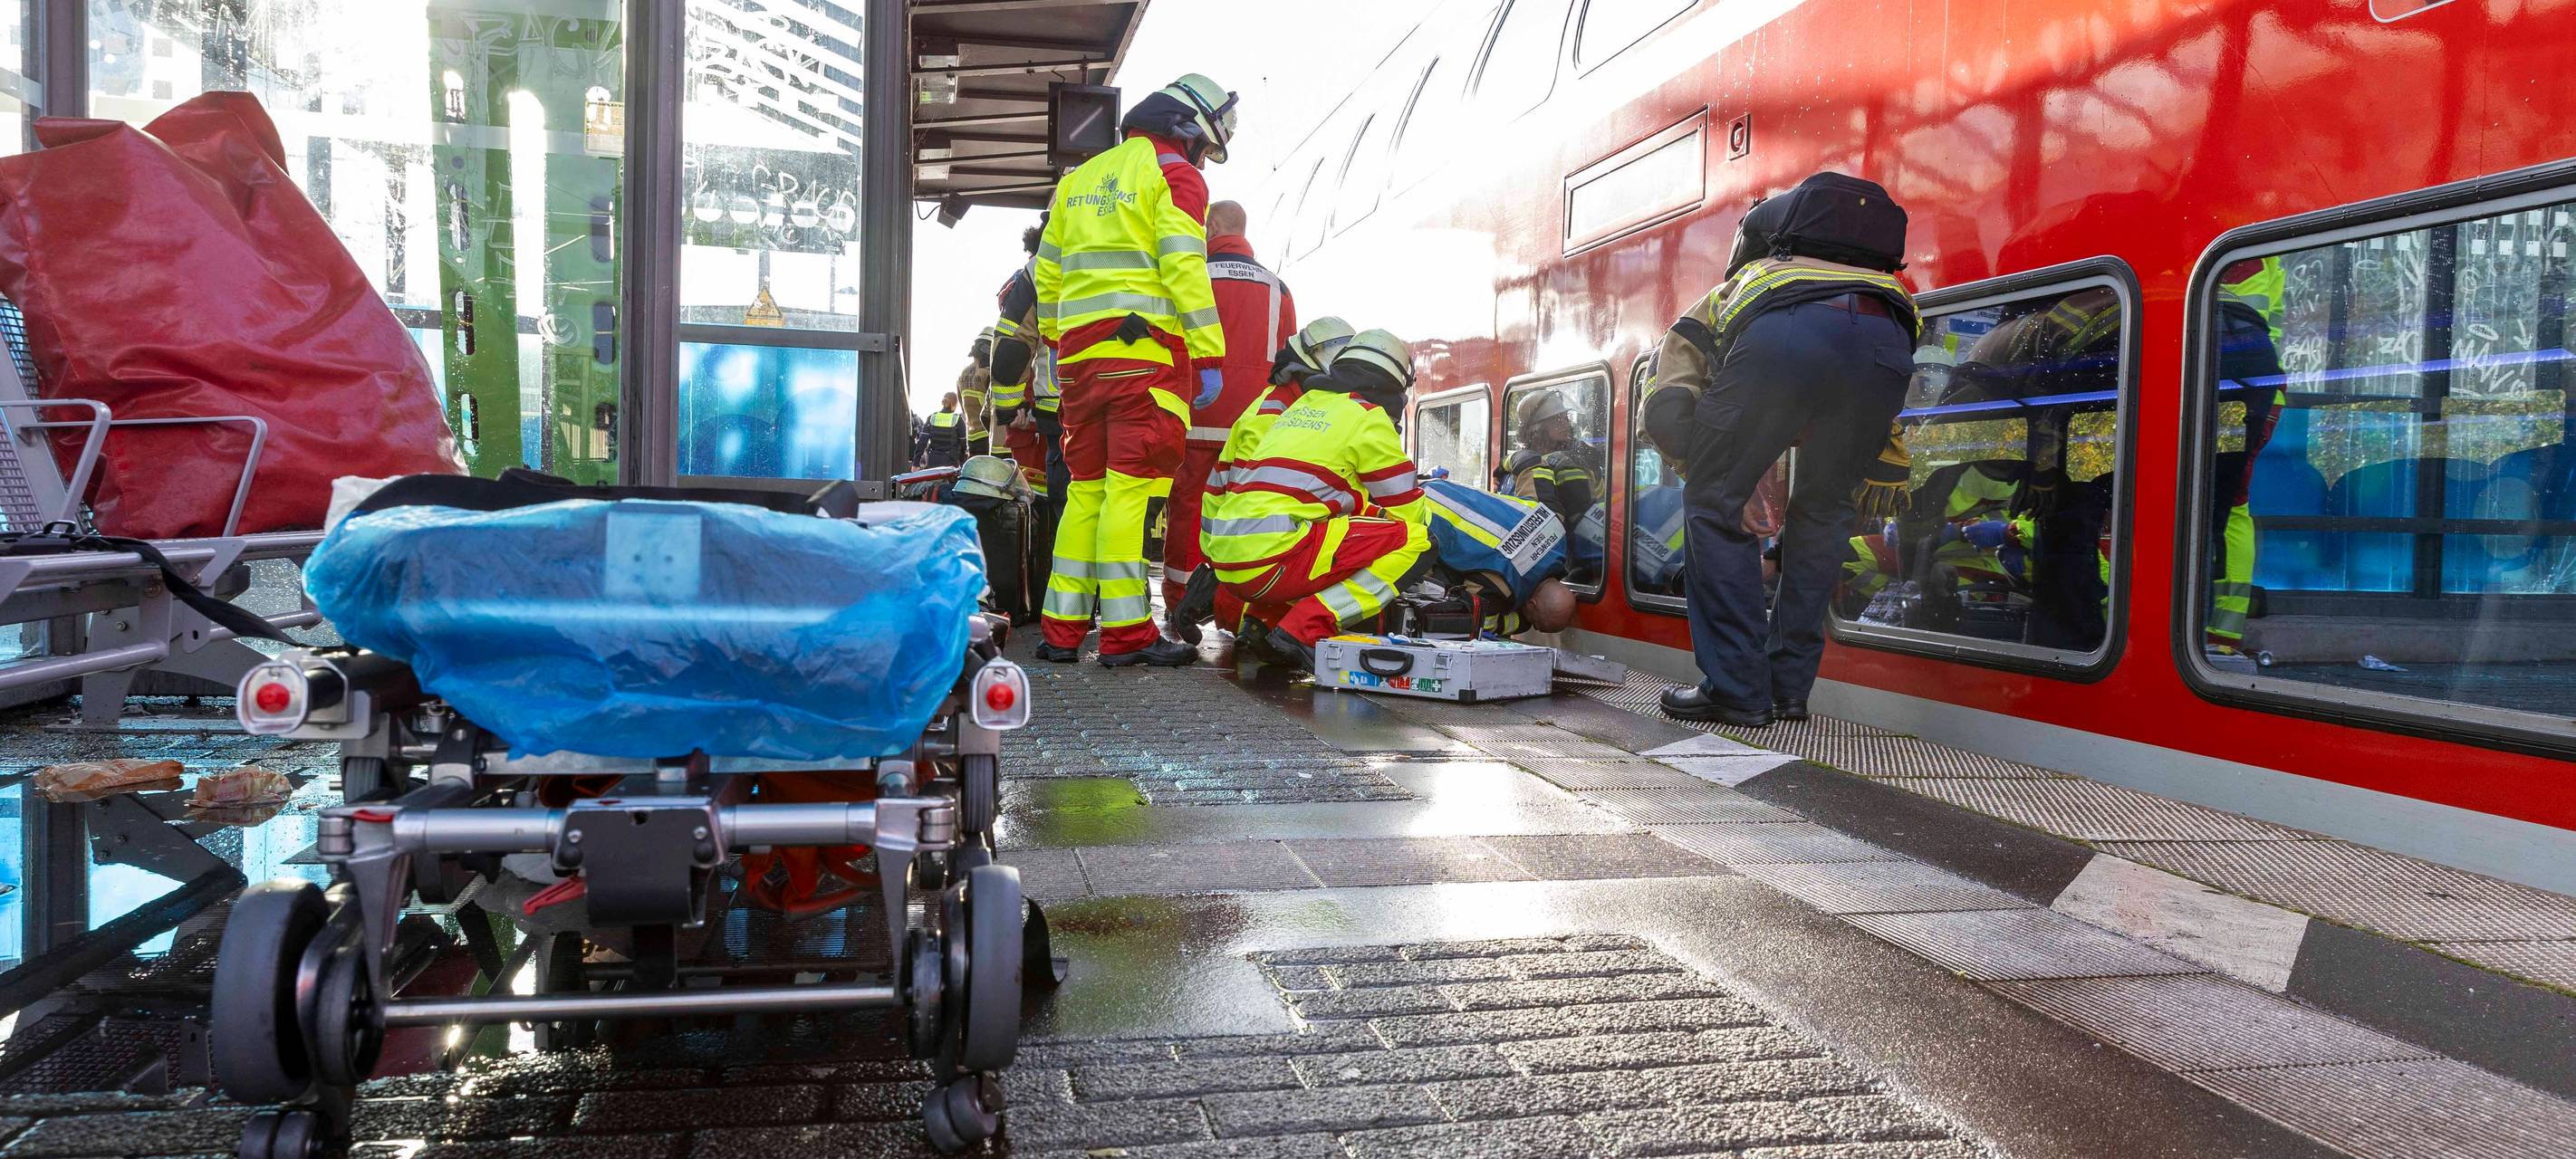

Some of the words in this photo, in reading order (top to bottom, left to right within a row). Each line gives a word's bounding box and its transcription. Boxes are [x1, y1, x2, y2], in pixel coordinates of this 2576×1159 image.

[1097, 201, 1117, 216] ESEN
[1228, 269, 1254, 278] ESSEN
[1531, 532, 1558, 561] FEUEWEHR
